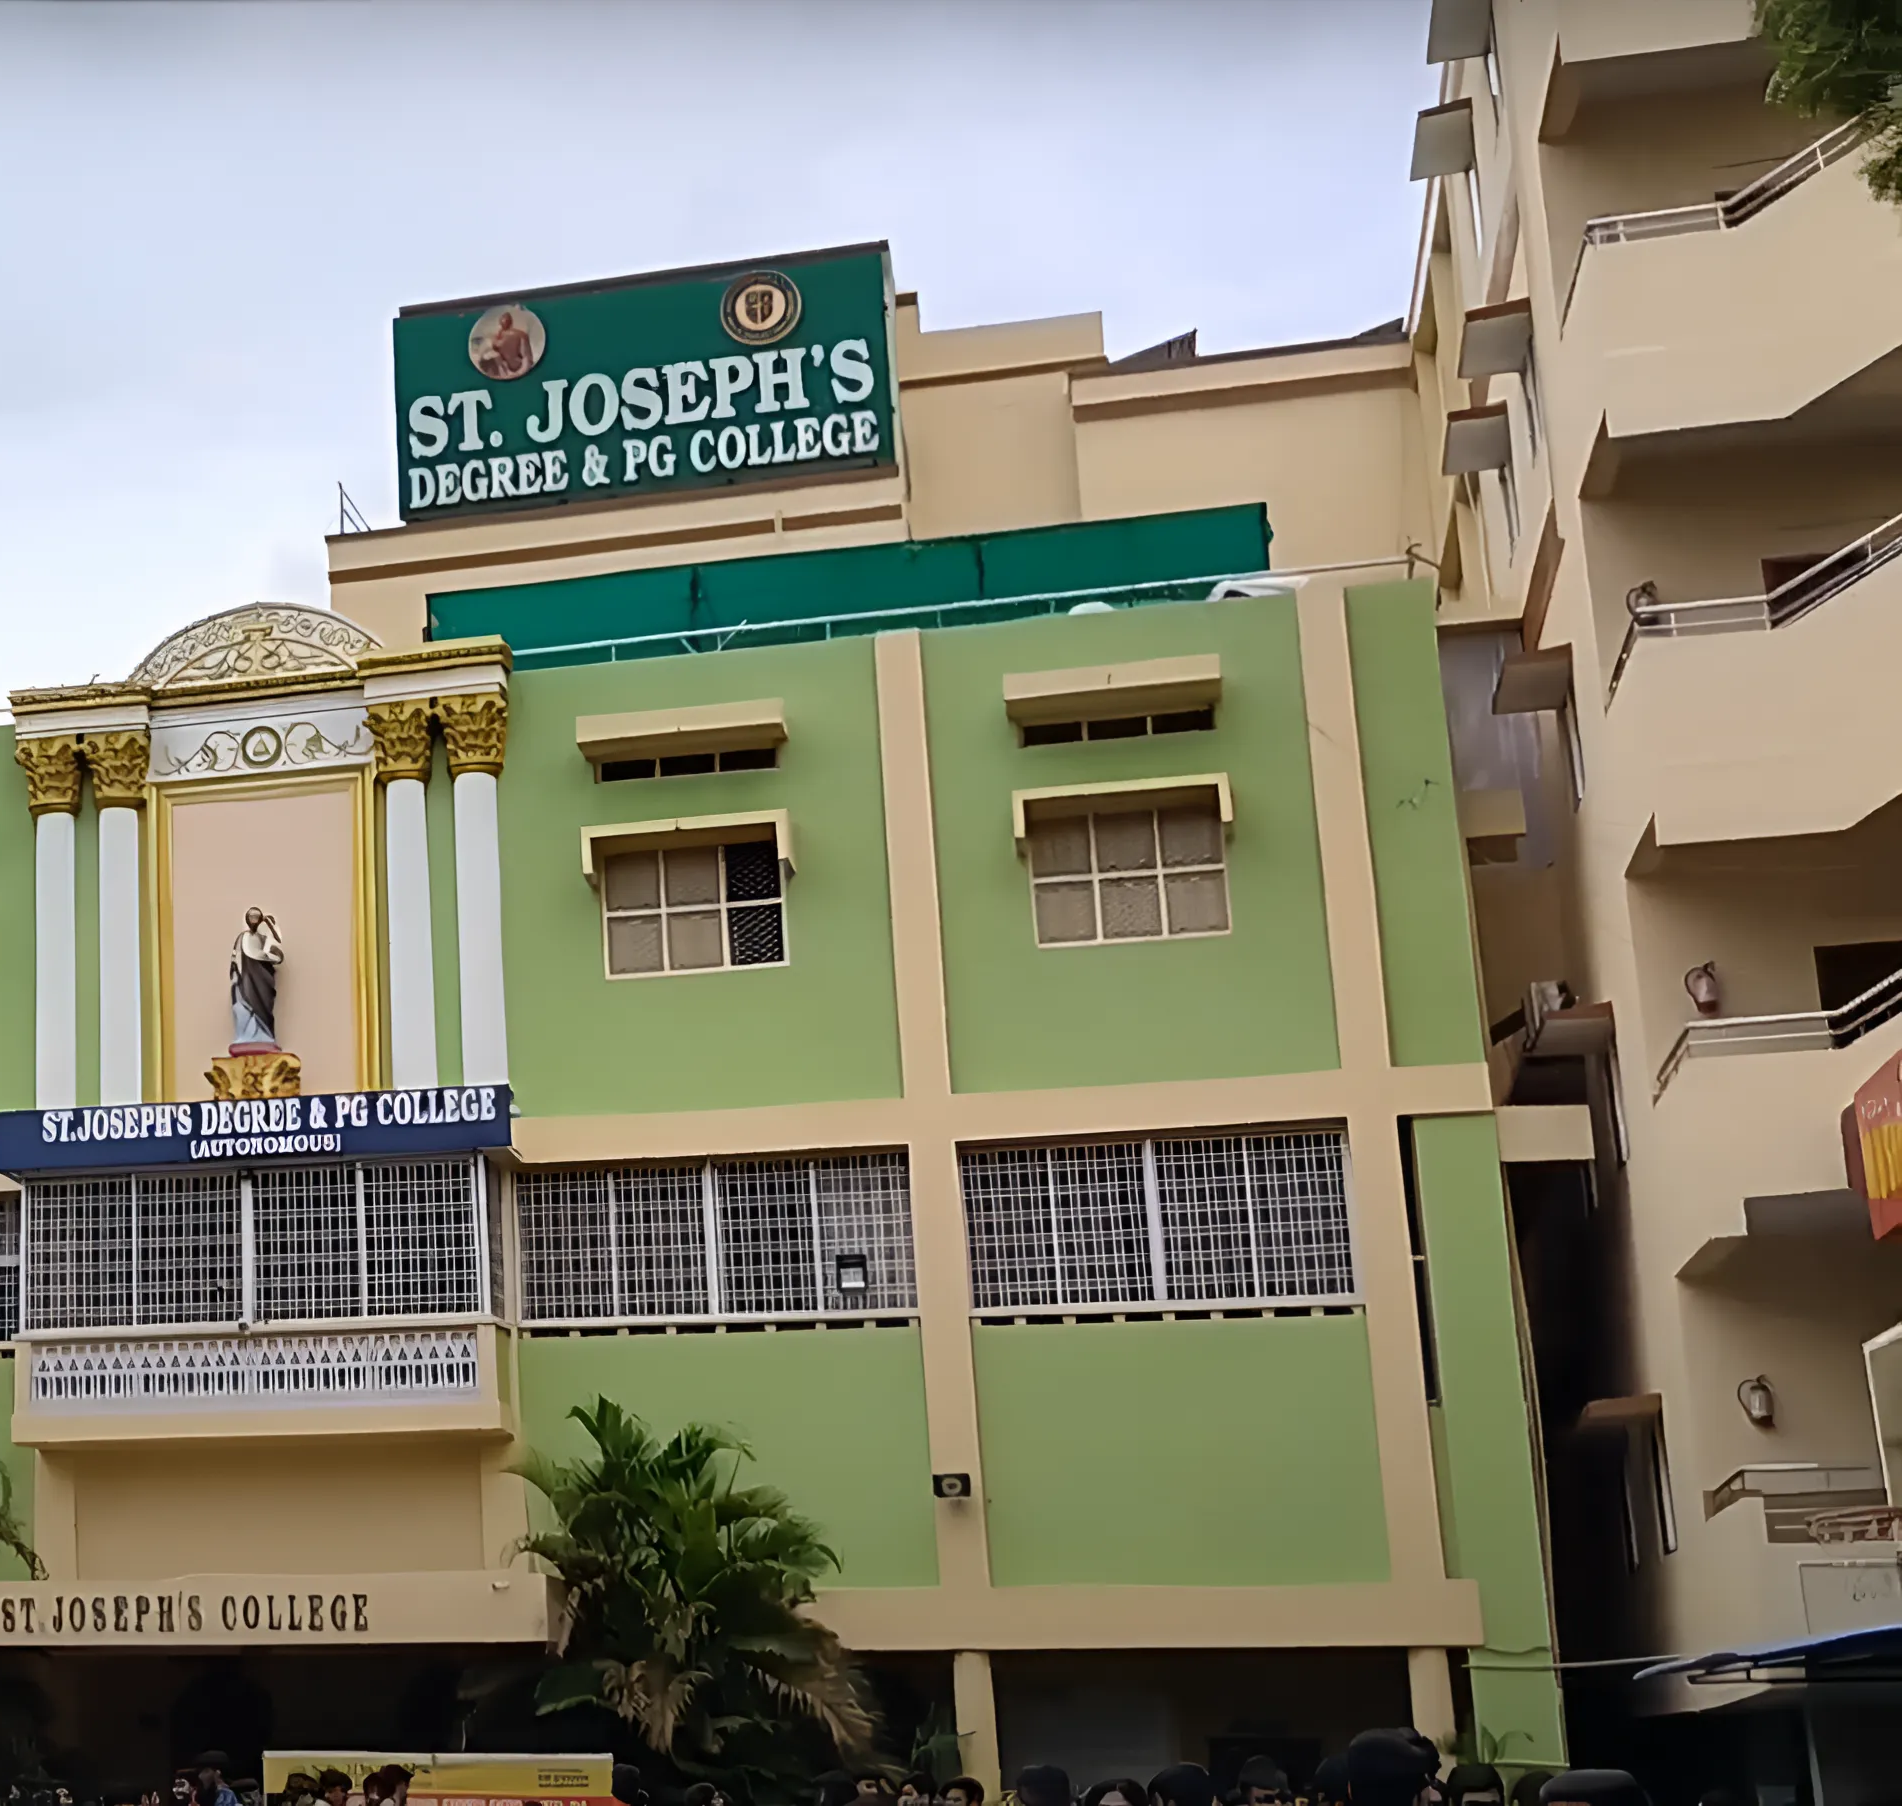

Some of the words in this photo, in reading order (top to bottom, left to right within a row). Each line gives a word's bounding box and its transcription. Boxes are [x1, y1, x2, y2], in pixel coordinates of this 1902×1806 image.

[408, 389, 503, 459] ST.
[526, 338, 875, 443] JOSEPH'S
[408, 449, 570, 509] DEGREE
[582, 444, 611, 487] &
[623, 435, 676, 483] PG
[689, 410, 879, 473] COLLEGE
[200, 1097, 302, 1136] DEGREE
[309, 1097, 328, 1130] &
[334, 1094, 369, 1129] PG
[376, 1087, 496, 1126] COLLEGE
[52, 1590, 203, 1633] JOSEPH'S
[221, 1593, 369, 1632] COLLEGE
